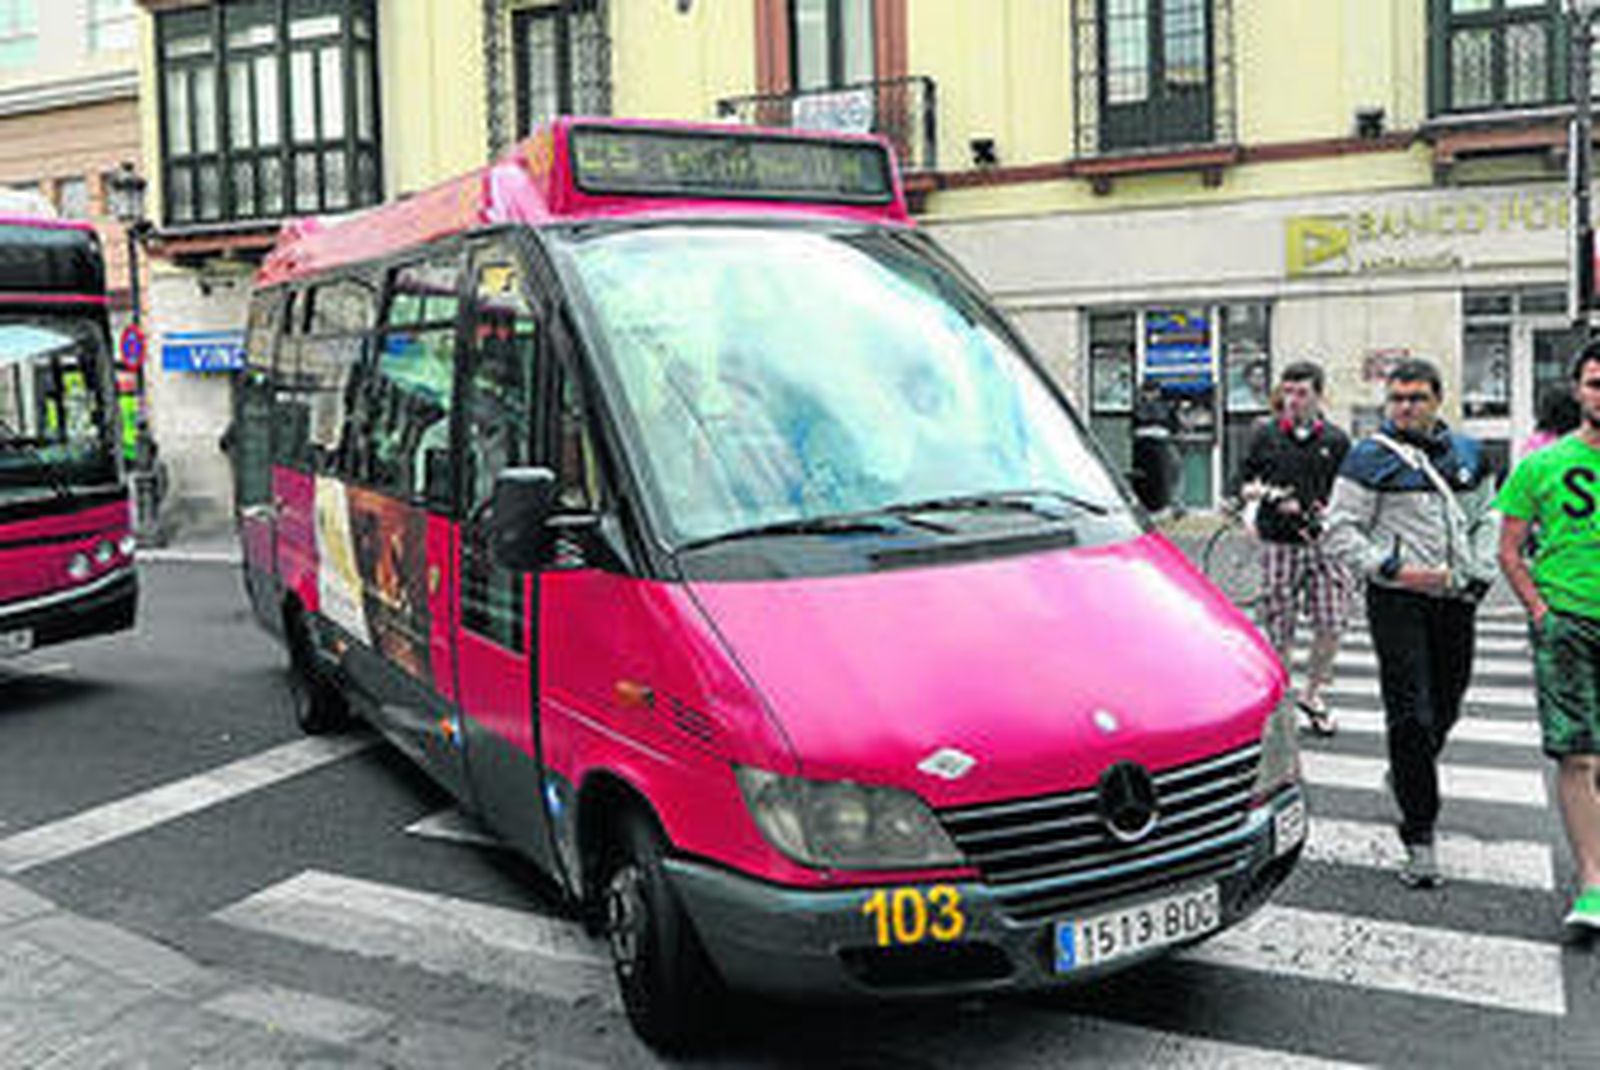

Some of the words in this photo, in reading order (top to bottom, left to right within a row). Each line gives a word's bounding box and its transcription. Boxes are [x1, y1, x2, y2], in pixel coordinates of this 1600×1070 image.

[1358, 200, 1487, 240] BANCO
[1562, 466, 1595, 519] S
[862, 884, 965, 946] 103
[1084, 911, 1152, 958] 1513
